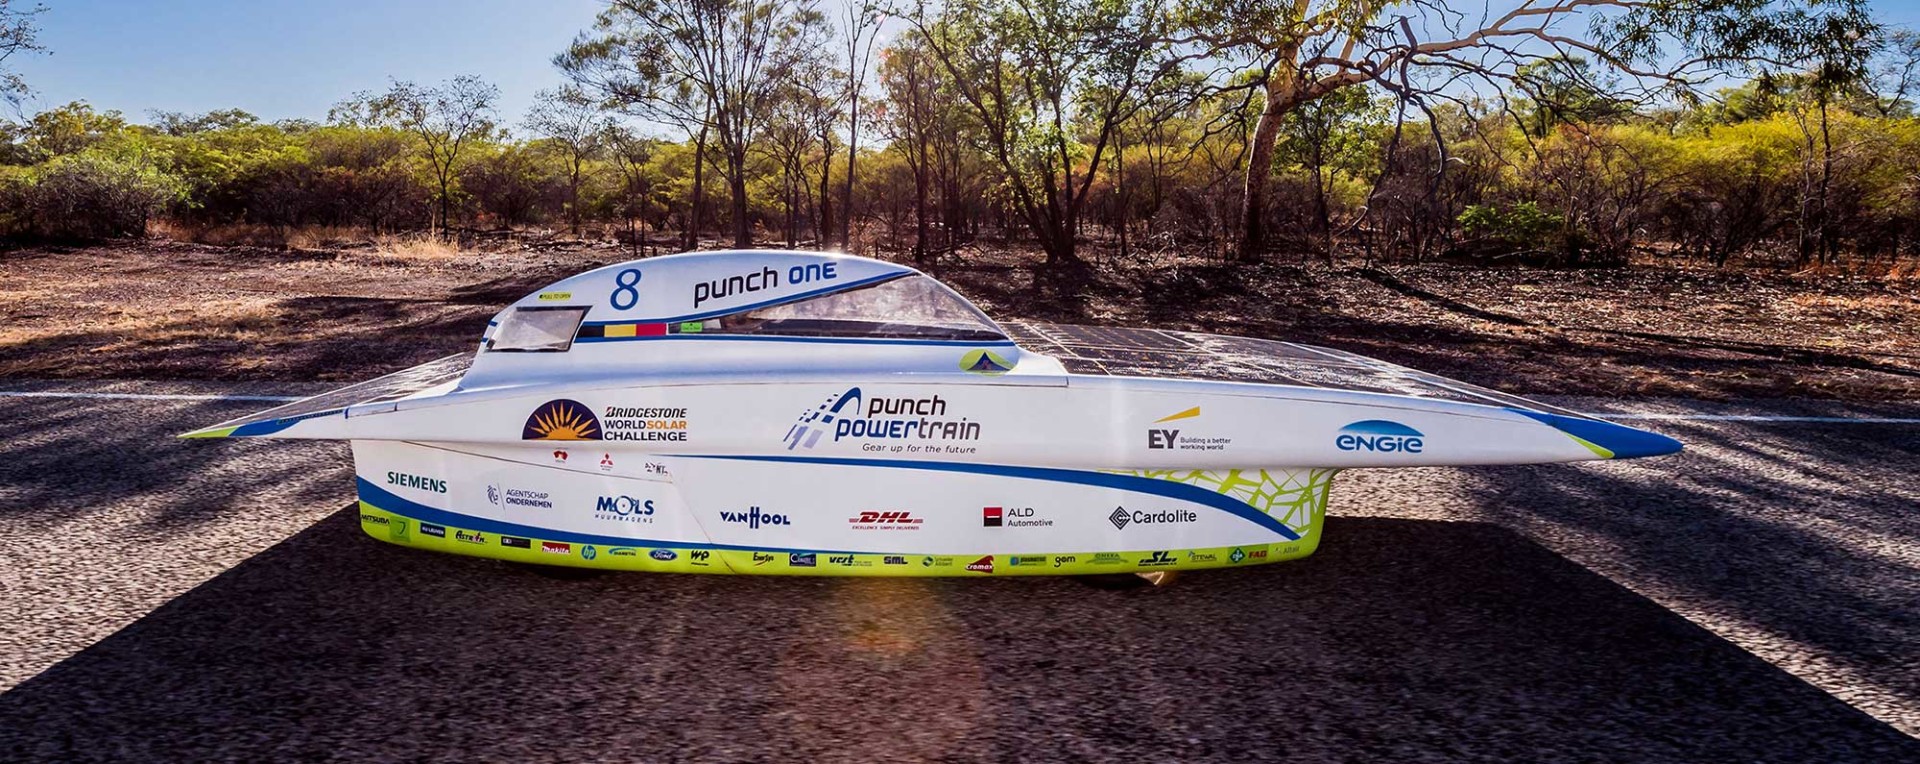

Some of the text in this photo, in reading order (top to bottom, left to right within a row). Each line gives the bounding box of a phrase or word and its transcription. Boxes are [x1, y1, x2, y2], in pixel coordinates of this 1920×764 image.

[610, 268, 642, 311] 8
[694, 266, 778, 308] punch
[604, 406, 687, 418] BRIDGESTONE
[868, 394, 946, 418] punch
[604, 431, 687, 442] CHALLENGE
[1148, 430, 1180, 449] EY
[862, 443, 976, 454] Gear up for the future
[387, 471, 447, 494] SIEMENS
[506, 489, 548, 499] AGENTSCHAP
[506, 496, 552, 508] ONDERNEMEN
[596, 496, 654, 516] MOLS
[859, 512, 914, 523] DHL
[1008, 508, 1034, 517] ALD
[1132, 510, 1197, 524] Cardolite
[594, 514, 652, 524] HUURWAGENS
[1008, 518, 1053, 527] Automotive
